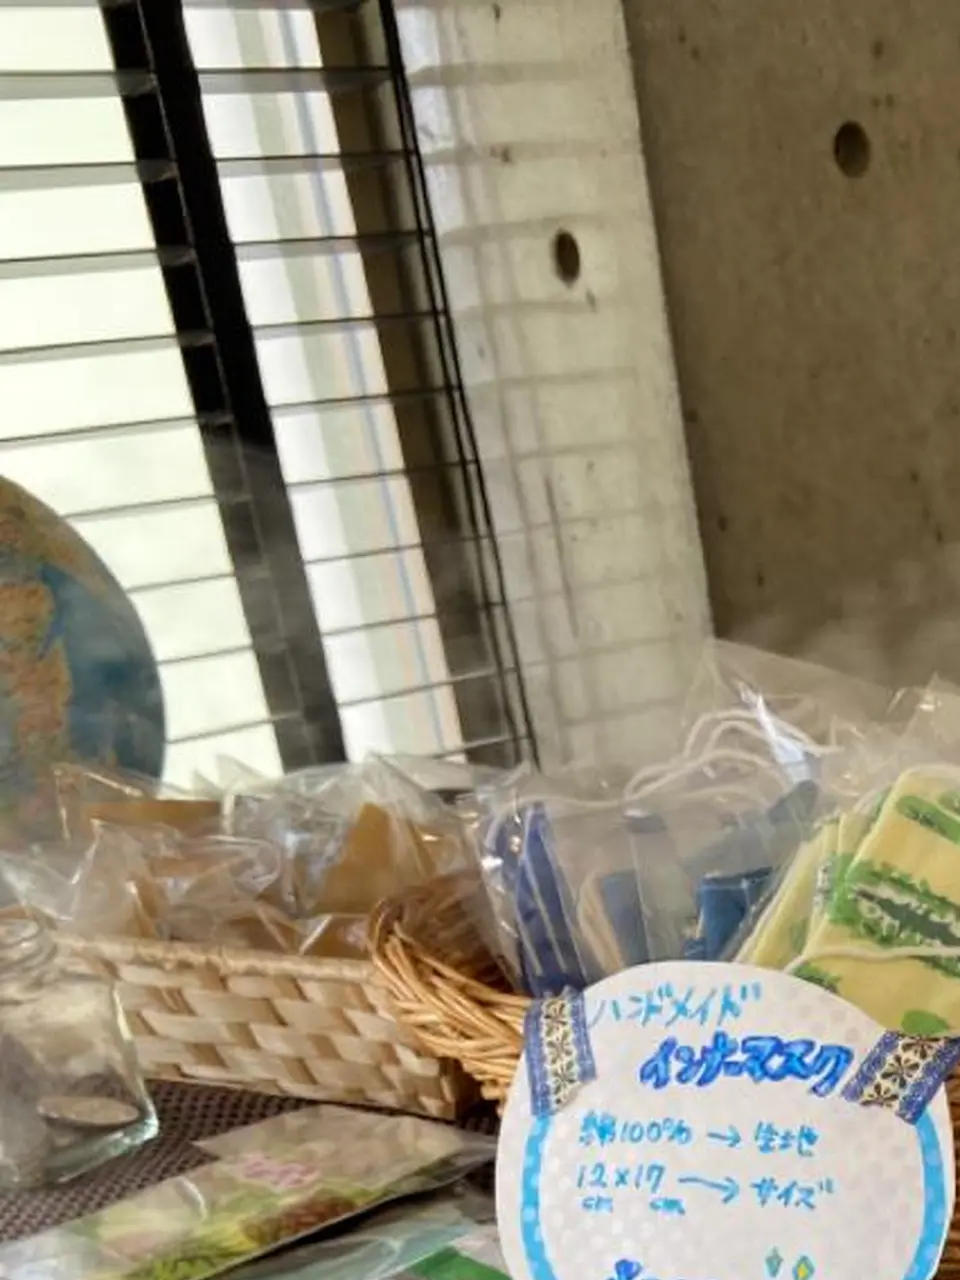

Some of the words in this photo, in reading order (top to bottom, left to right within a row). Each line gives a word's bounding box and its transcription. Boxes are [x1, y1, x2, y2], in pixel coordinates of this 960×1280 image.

[589, 981, 763, 1028] ハンドメイド
[638, 1029, 855, 1098] インナーマスク
[753, 1118, 820, 1157] 生地
[750, 1175, 835, 1210] サイズ
